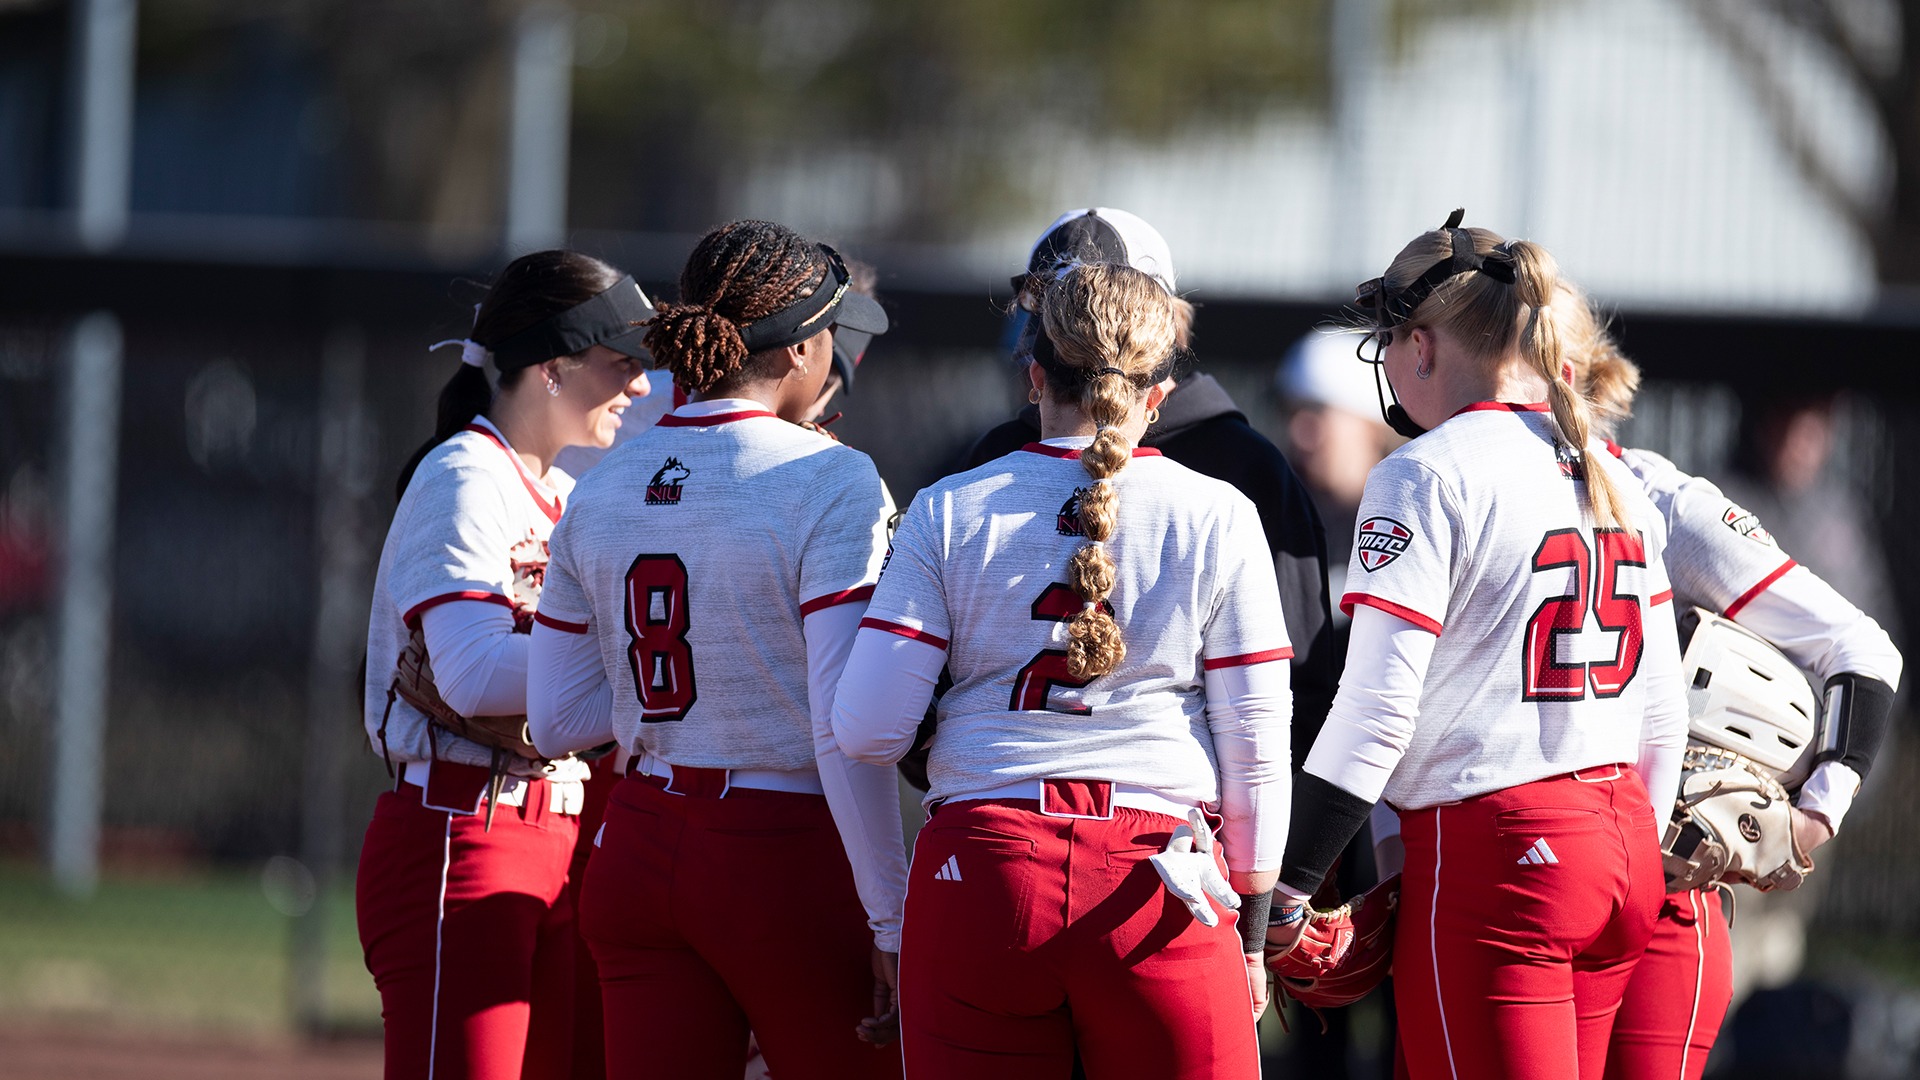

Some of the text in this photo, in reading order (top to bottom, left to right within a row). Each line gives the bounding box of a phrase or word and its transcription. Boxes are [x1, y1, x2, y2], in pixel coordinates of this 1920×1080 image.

[646, 486, 681, 500] NIU
[1057, 515, 1084, 532] NI
[1358, 534, 1405, 554] MAC
[625, 553, 697, 722] 8
[1009, 582, 1115, 716] 2
[1522, 527, 1646, 702] 25
